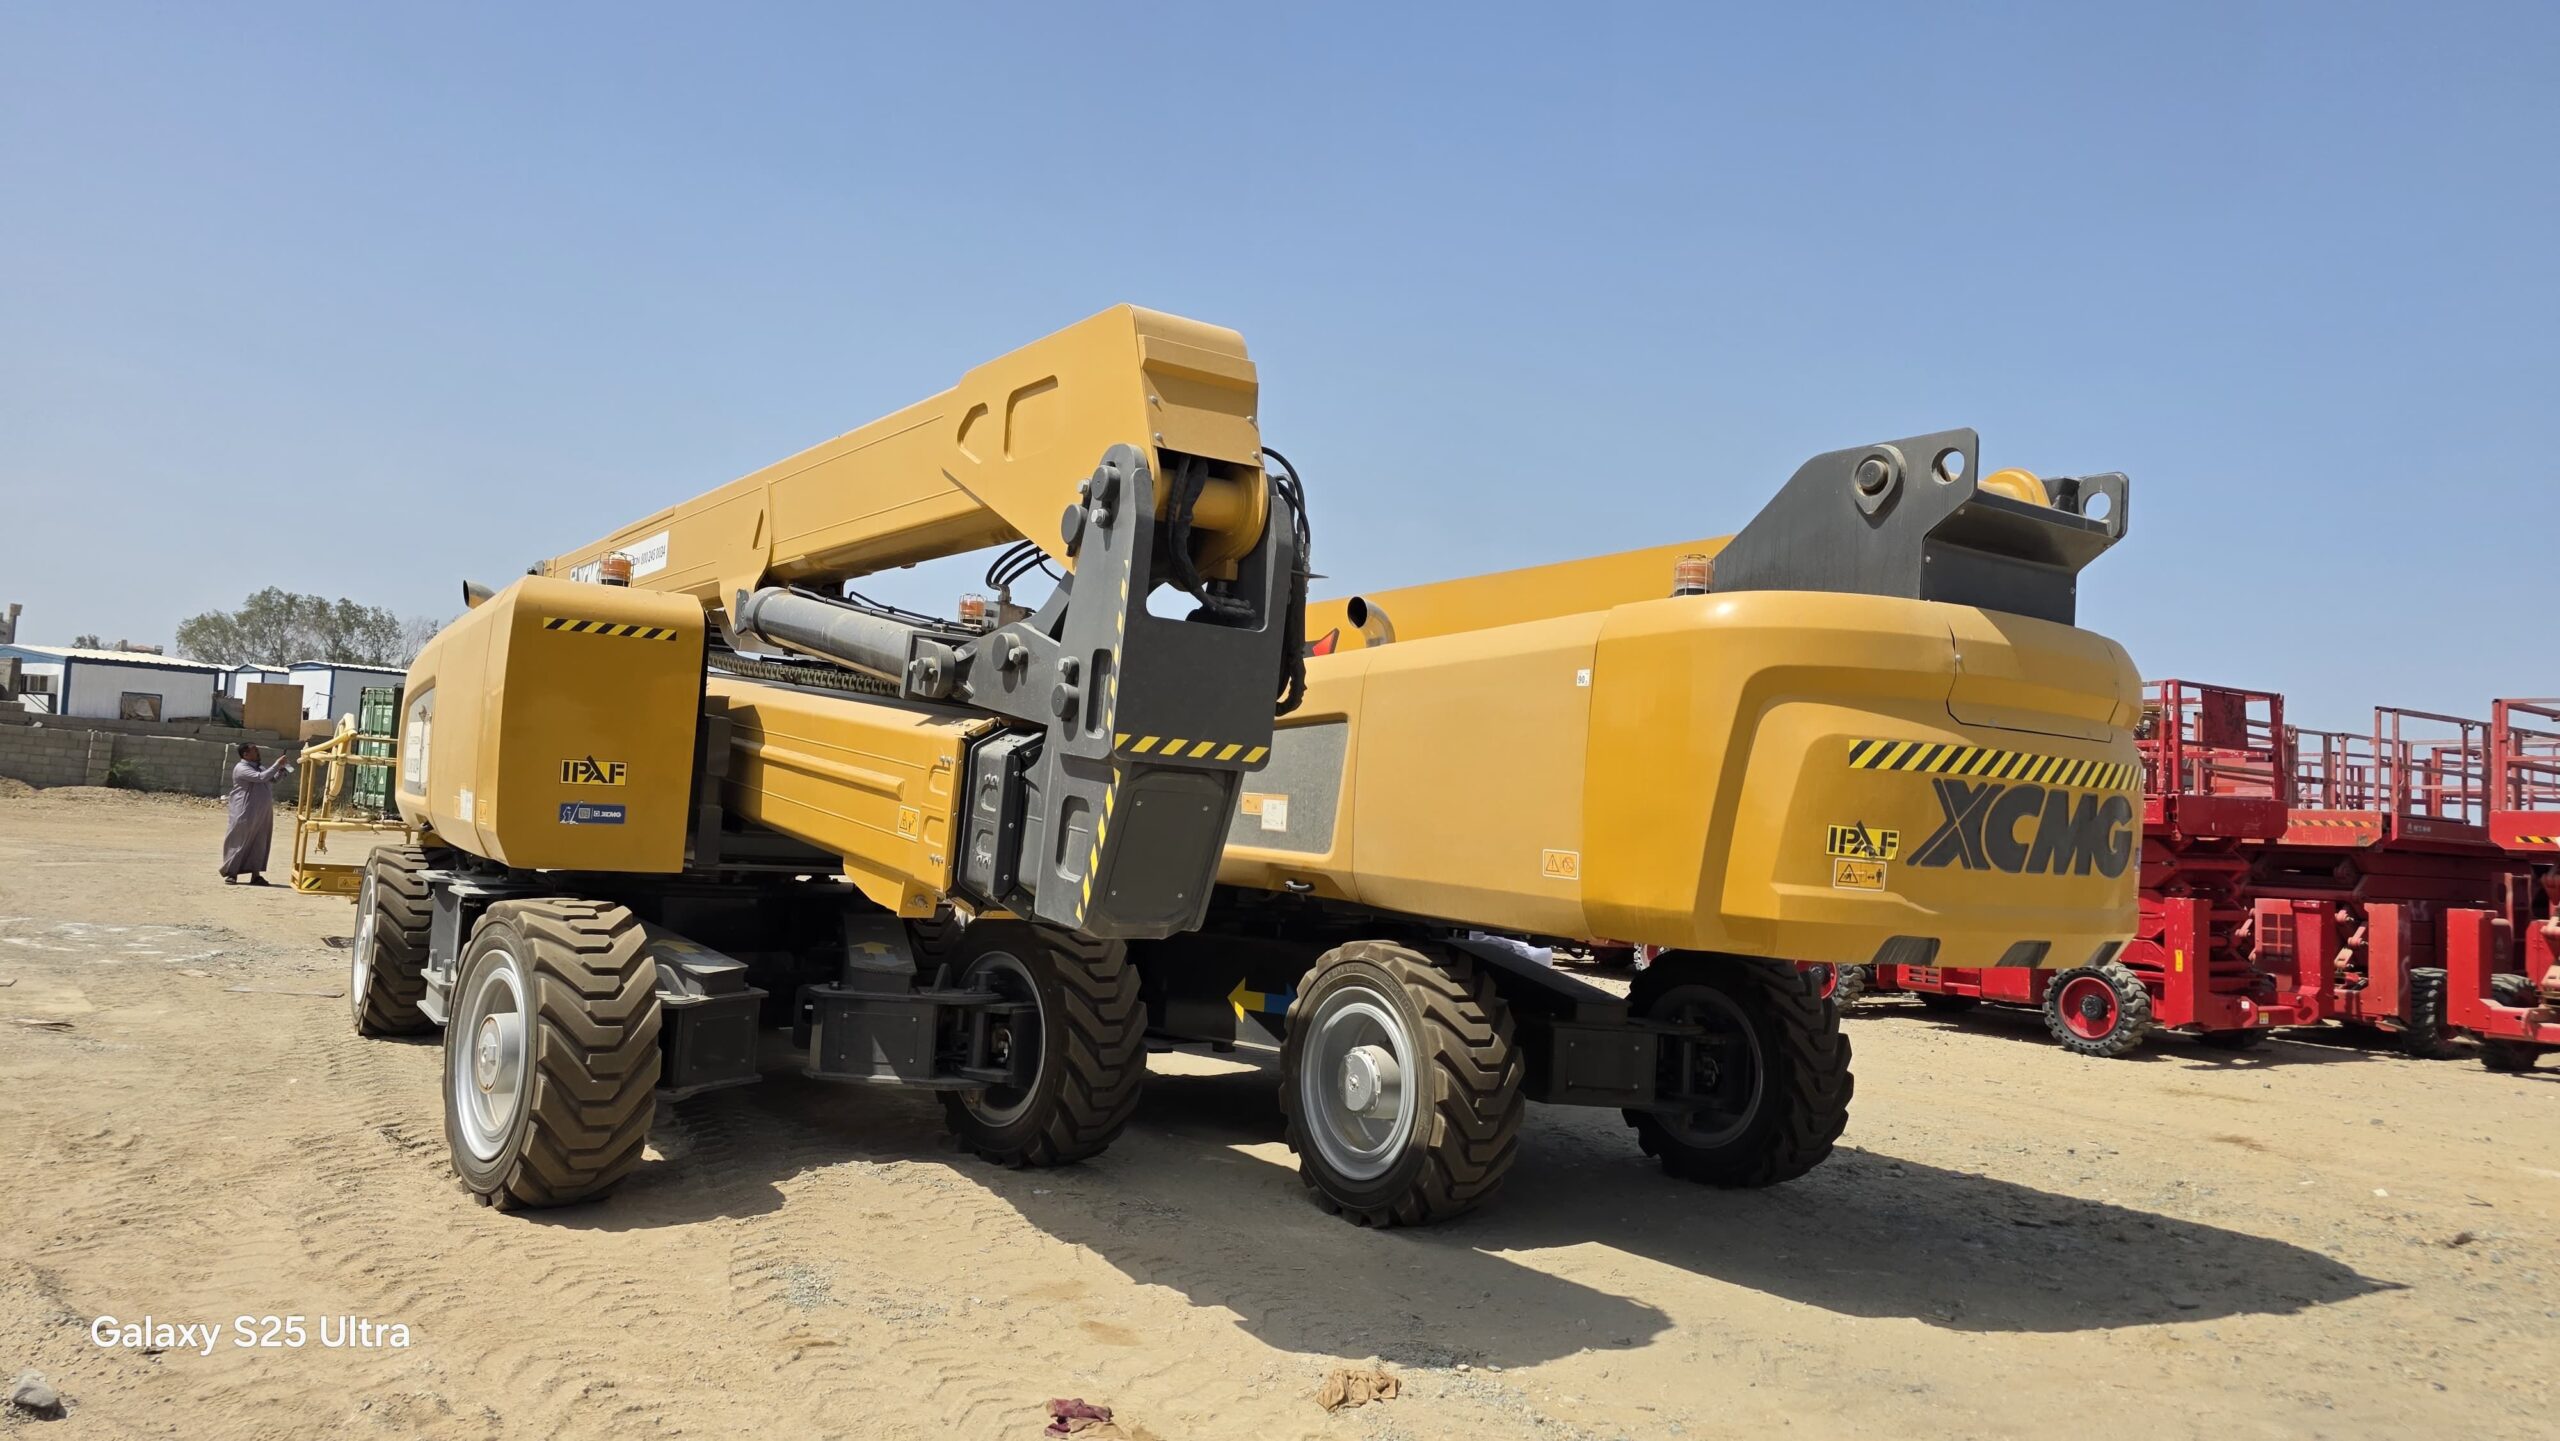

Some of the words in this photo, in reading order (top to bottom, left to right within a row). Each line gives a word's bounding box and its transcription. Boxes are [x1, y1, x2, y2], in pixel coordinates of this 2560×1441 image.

[562, 755, 625, 784] IPAF
[1829, 820, 1898, 857] IPAF
[1906, 778, 2133, 878] XCMG
